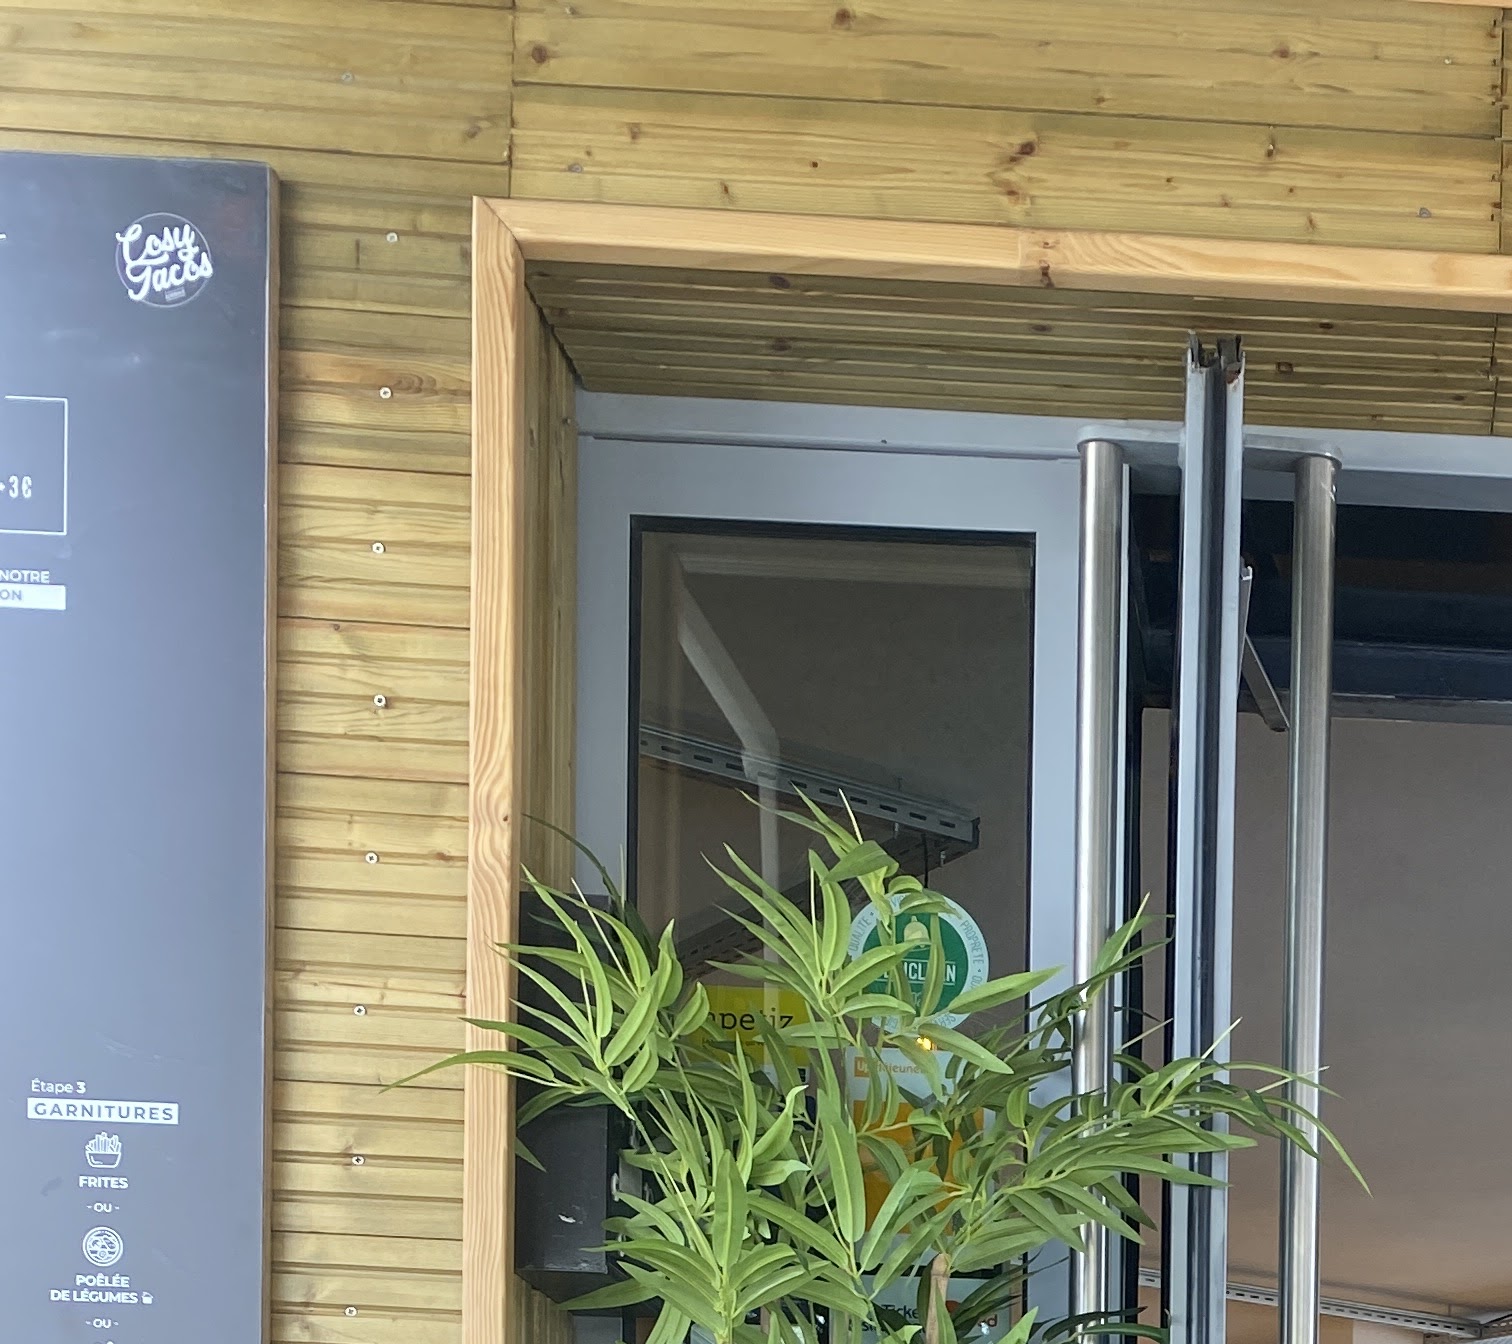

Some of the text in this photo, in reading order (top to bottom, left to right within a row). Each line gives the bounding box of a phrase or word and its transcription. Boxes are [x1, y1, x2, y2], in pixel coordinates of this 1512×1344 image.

[115, 223, 199, 262] Cosy
[126, 251, 213, 301] Tacos
[31, 1078, 87, 1095] Étape 3
[34, 1102, 174, 1121] GARNITURES
[78, 1175, 129, 1189] FRITES
[75, 1273, 130, 1288] POÊLÉE
[49, 1287, 139, 1304] DE LÉGUMES
